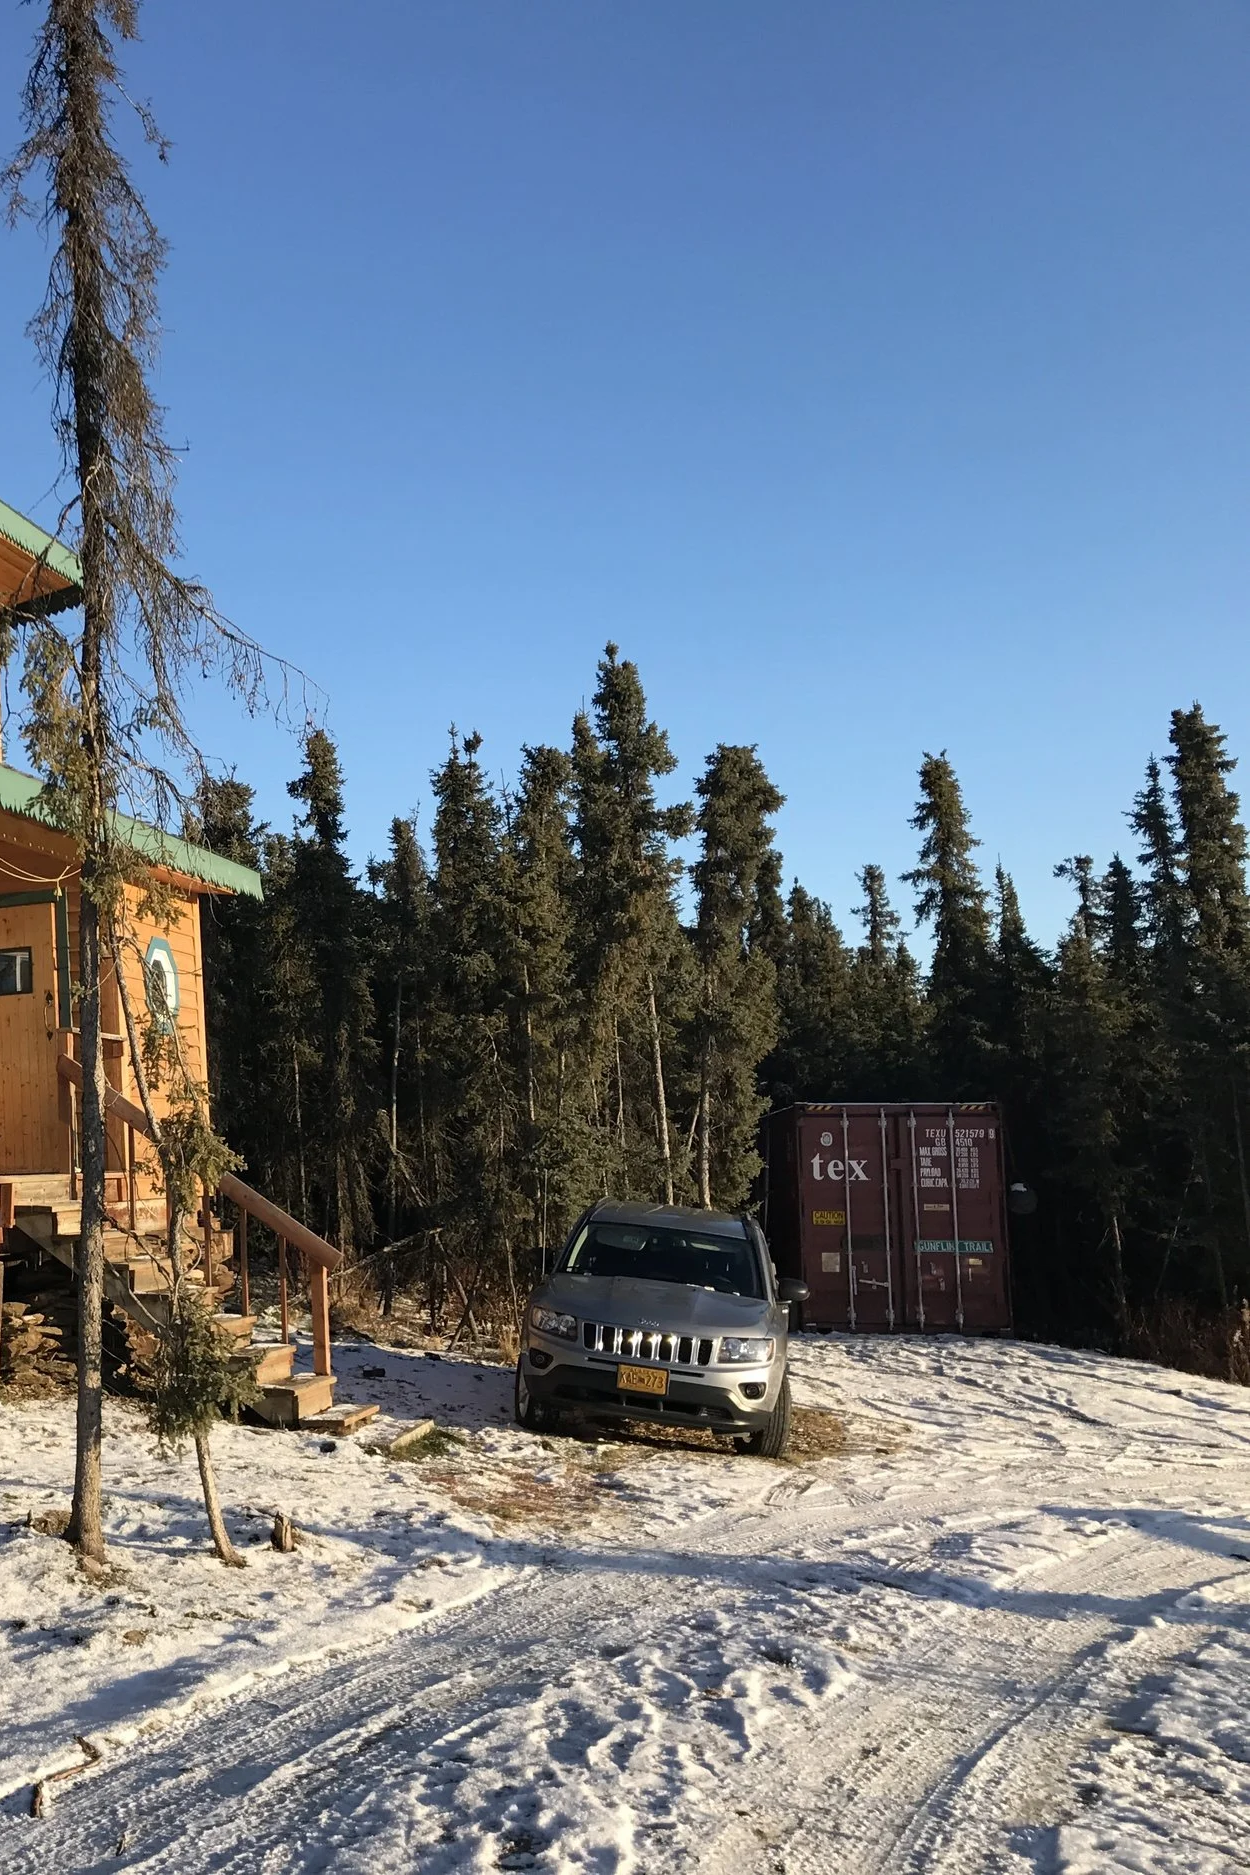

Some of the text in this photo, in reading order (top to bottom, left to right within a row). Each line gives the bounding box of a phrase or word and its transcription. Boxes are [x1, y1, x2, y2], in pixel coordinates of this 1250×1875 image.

[925, 1129, 946, 1138] TEXU
[955, 1129, 985, 1138] 521579
[955, 1138, 973, 1147] 4510
[932, 1147, 947, 1156] GROSS
[810, 1153, 868, 1181] tex
[920, 1168, 941, 1177] PAYLOAD
[921, 1178, 934, 1187] CUBIC
[814, 1211, 844, 1219] CAUTION
[919, 1241, 989, 1251] GUNFLIN TRAIL
